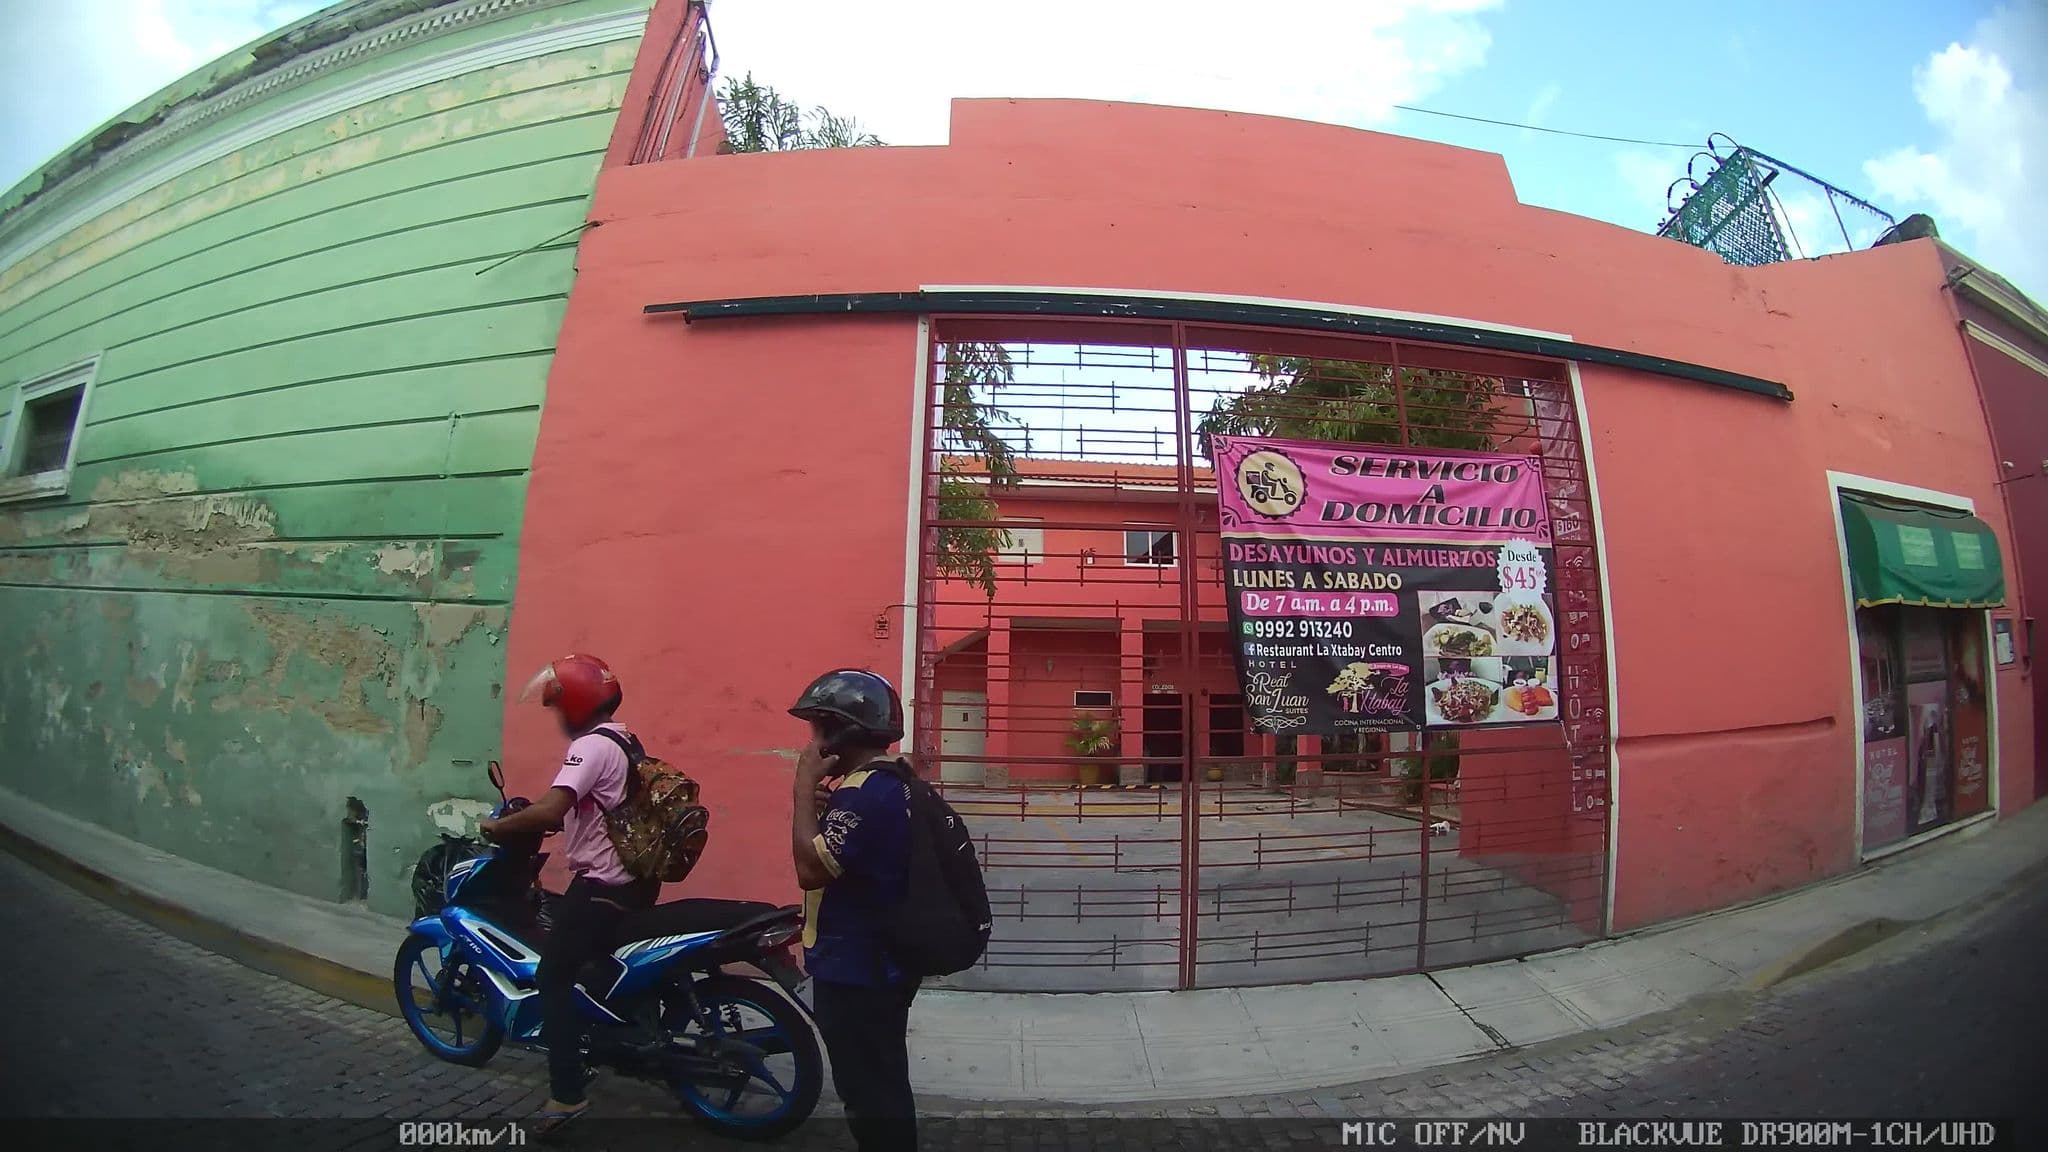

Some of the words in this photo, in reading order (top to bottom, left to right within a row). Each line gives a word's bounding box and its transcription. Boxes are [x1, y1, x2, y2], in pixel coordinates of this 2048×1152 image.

[1329, 455, 1519, 483] SERVICIO
[1418, 483, 1446, 504] A
[1319, 500, 1537, 528] DOMICILIO
[1229, 543, 1357, 565] DESAYUNOS
[1365, 548, 1375, 566] Y
[1382, 549, 1496, 568] ALMUERZOS
[1507, 550, 1537, 562] Desde
[1233, 569, 1296, 588] LUNES
[1302, 571, 1317, 589] A
[1323, 571, 1403, 590] SABADO
[1246, 593, 1270, 611] De
[1275, 594, 1286, 612] 7
[1291, 597, 1326, 612] a.m.
[1330, 598, 1341, 612] a
[1345, 595, 1356, 612] 4
[1359, 598, 1394, 615] p.m.
[1255, 621, 1294, 638] 9992
[1300, 620, 1353, 638] 913240
[1257, 643, 1314, 657] Restaurant
[1317, 644, 1329, 656] La
[1331, 643, 1366, 658] Xtabay
[1368, 643, 1402, 657] Centro
[1248, 659, 1297, 669] HOTEL
[1246, 670, 1292, 694] Real
[1381, 676, 1409, 695] La
[1245, 684, 1271, 707] San
[1266, 688, 1310, 713] Juan
[1360, 690, 1411, 715] Xtabay
[1334, 719, 1359, 727] COCINA
[1359, 718, 1405, 726] INTERNACIONAL
